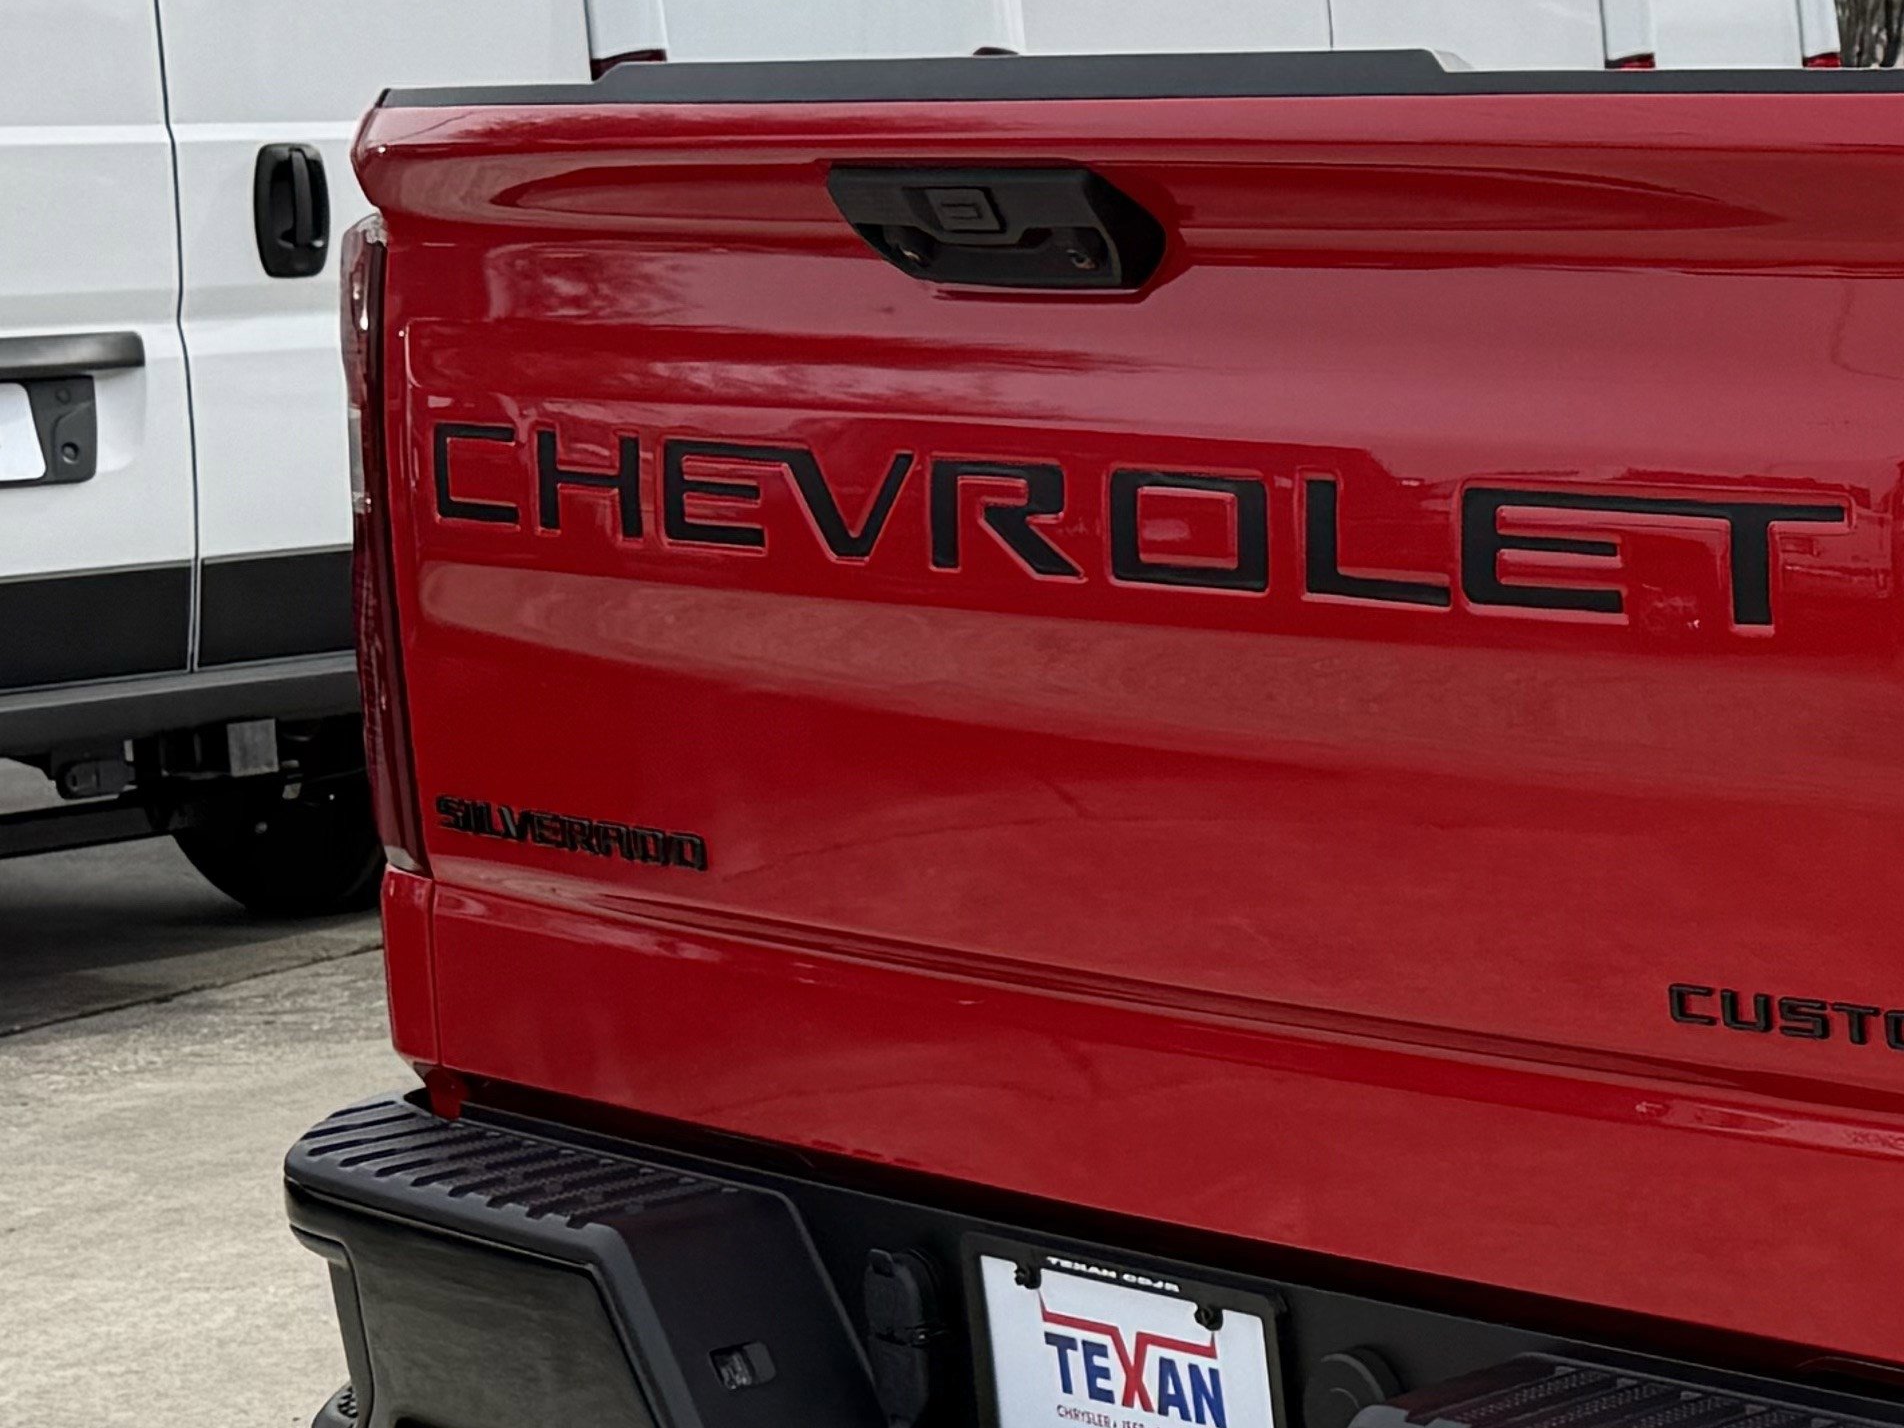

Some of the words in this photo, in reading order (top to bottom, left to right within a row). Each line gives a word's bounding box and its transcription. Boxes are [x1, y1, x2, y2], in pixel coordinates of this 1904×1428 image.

[432, 421, 1850, 632] CHEVROLET
[435, 794, 708, 871] SILVERADO
[1056, 1404, 1111, 1428] CHRYSLER
